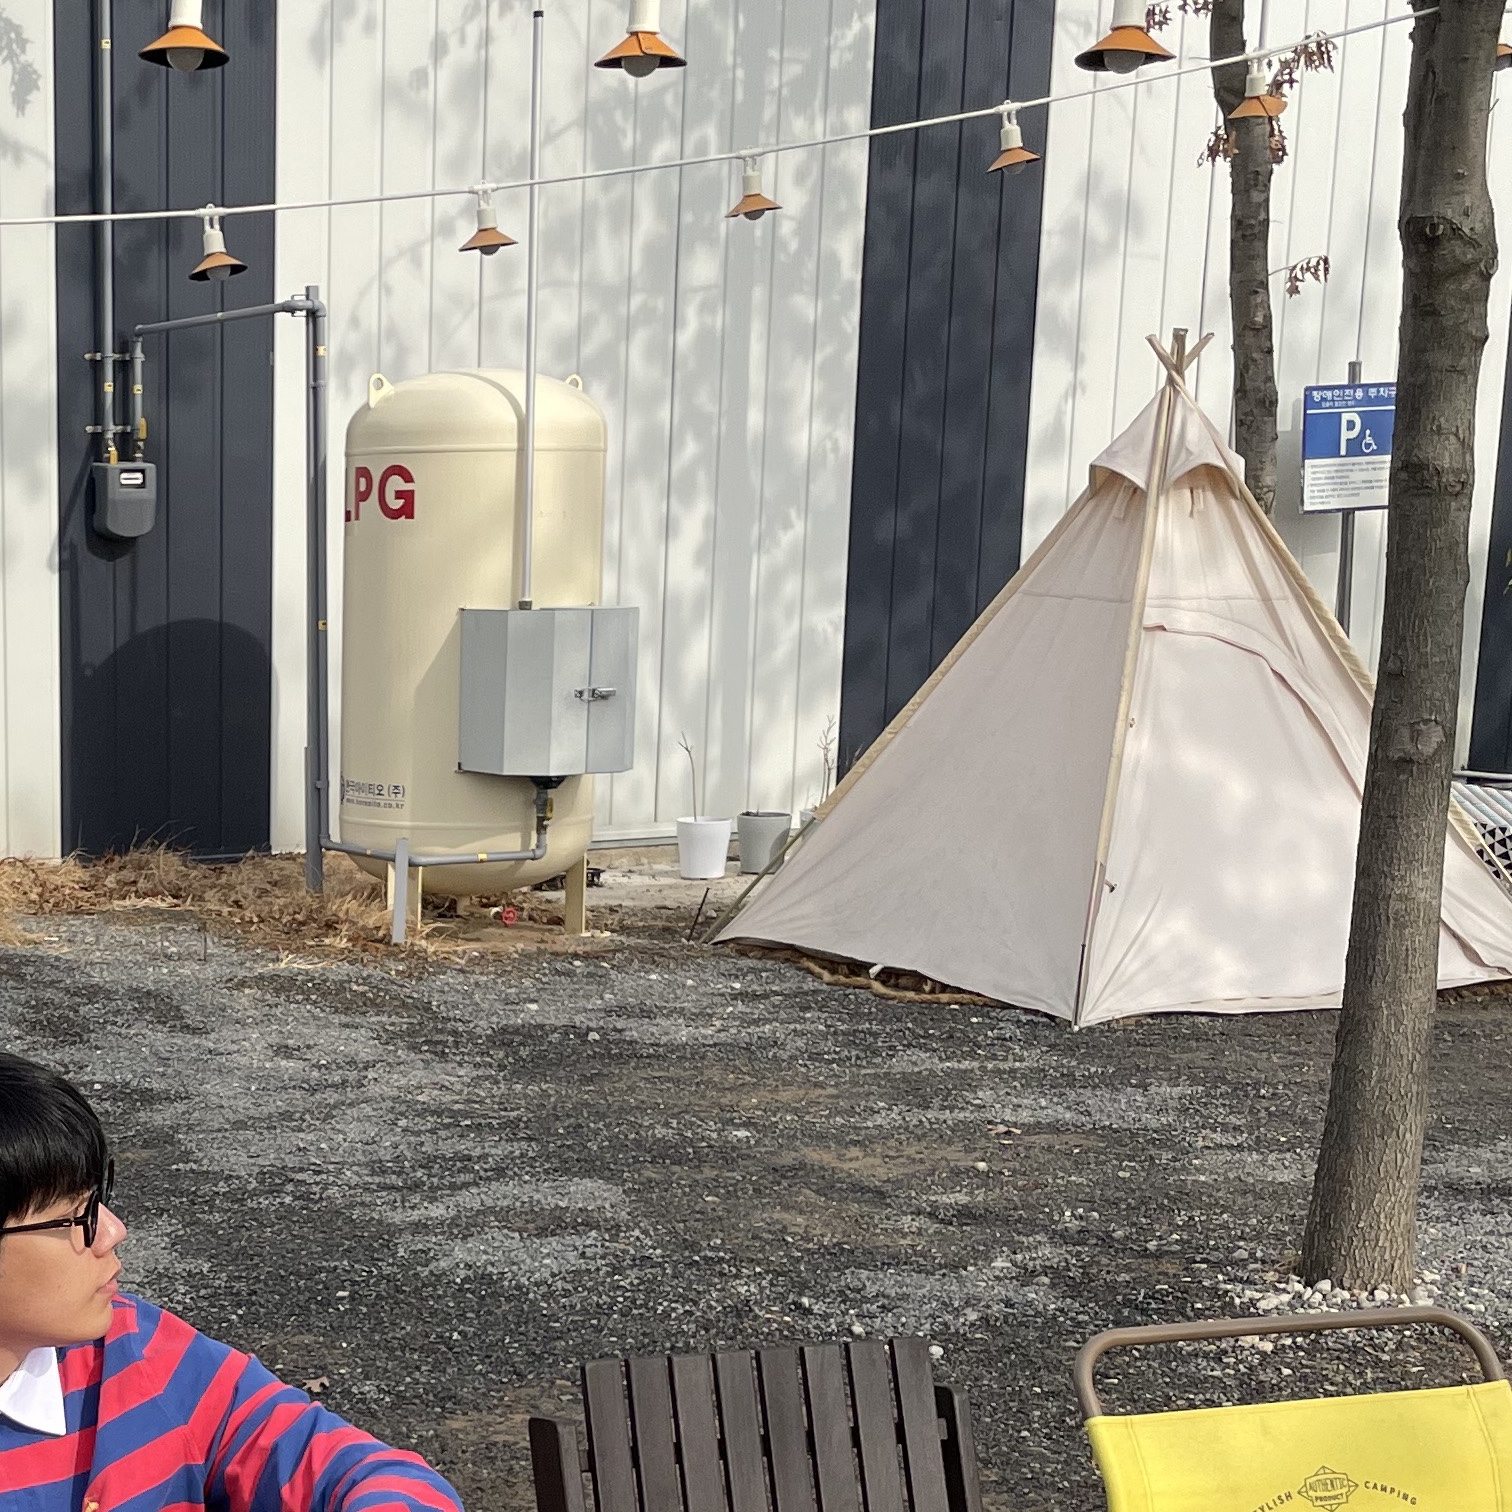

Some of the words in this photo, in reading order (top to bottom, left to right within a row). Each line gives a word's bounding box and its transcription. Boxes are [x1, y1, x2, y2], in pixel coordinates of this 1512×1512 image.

[1311, 388, 1364, 402] 장애인전용
[1368, 386, 1397, 399] 주차구
[1340, 412, 1362, 456] P
[345, 464, 415, 522] PG
[1308, 1477, 1347, 1493] AUTHENTIC
[1364, 1480, 1418, 1506] CAMPING
